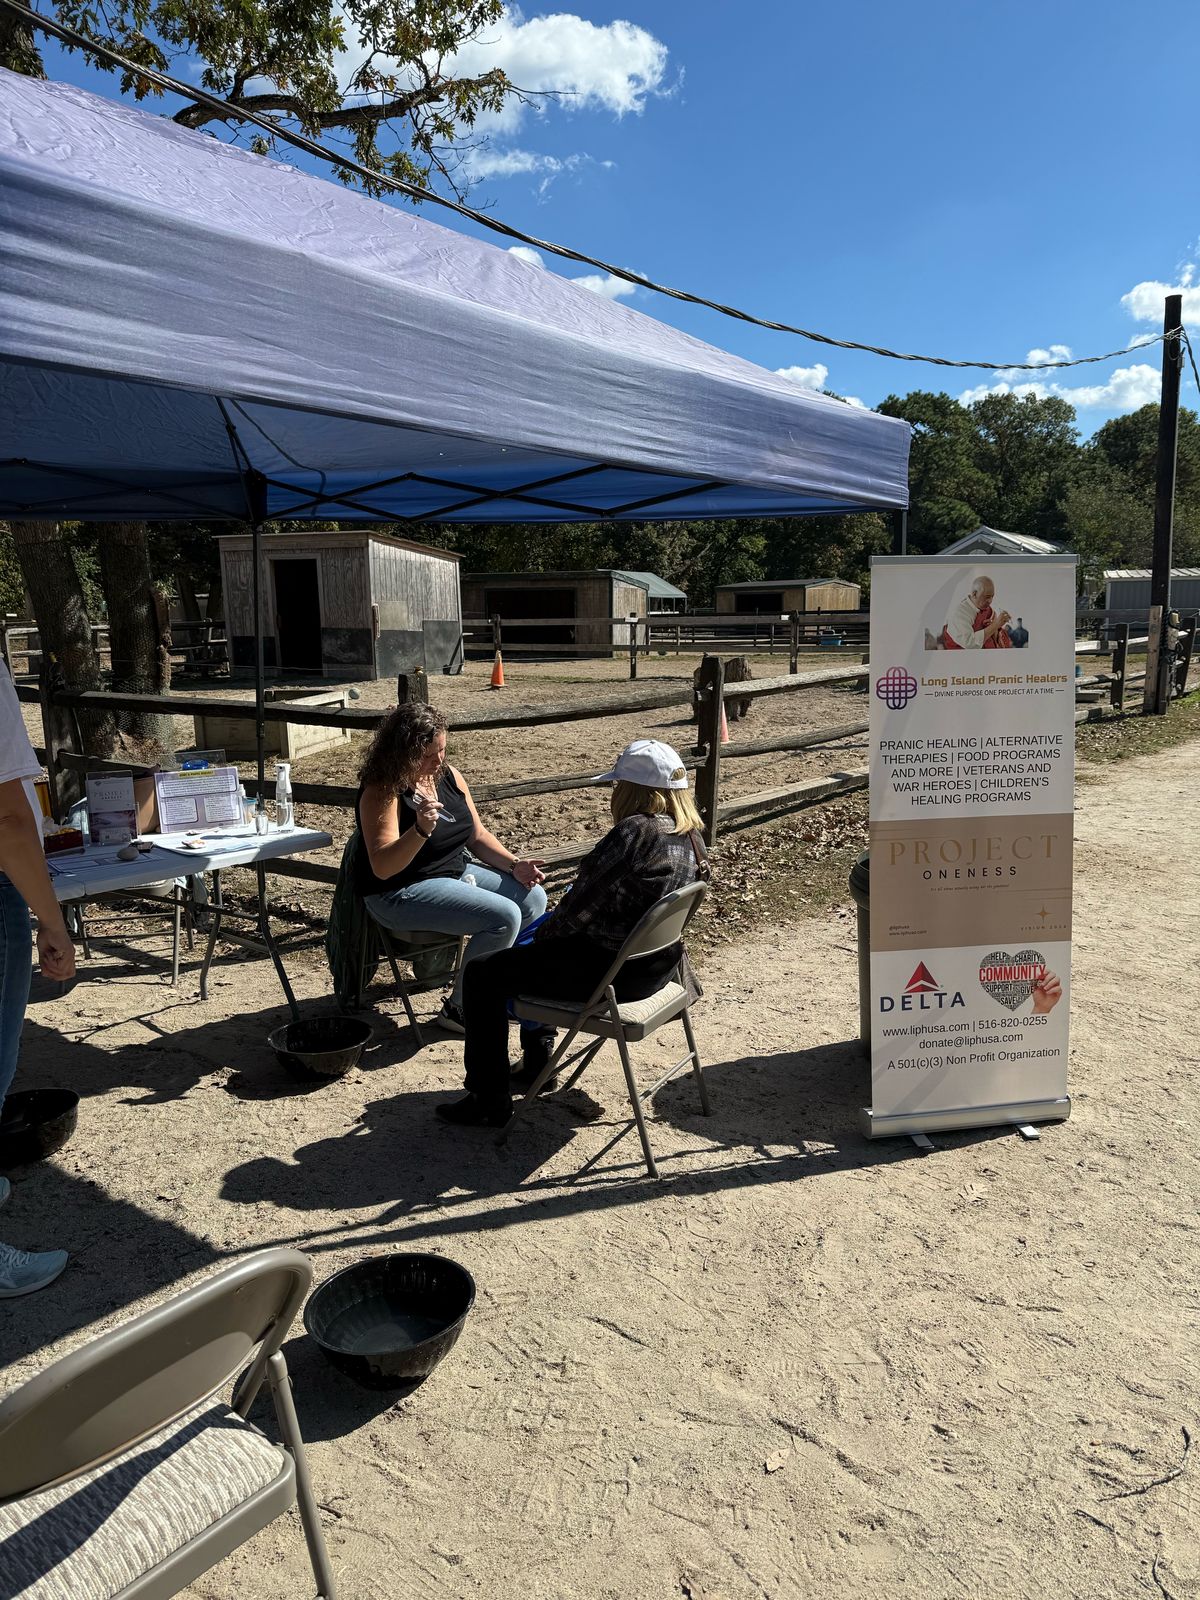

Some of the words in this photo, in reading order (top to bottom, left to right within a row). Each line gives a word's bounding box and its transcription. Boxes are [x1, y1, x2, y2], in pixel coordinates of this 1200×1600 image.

[921, 677, 948, 687] Long
[951, 676, 985, 686] Island
[988, 675, 1023, 684] Pranic
[1026, 674, 1068, 683] Healers
[956, 689, 983, 697] PURPOSE
[879, 739, 924, 750] PRANIC
[927, 737, 977, 748] HEALING
[985, 735, 1063, 747] ALTERNATIVE
[882, 753, 948, 764] THERAPIES
[957, 752, 990, 762] FOOD
[993, 749, 1061, 760] PROGRAMS
[891, 768, 916, 778] AND
[919, 767, 953, 777] MORE
[963, 764, 1025, 775] VETERANS
[1027, 763, 1051, 773] AND
[893, 782, 920, 792] WAR
[923, 780, 972, 791] HEROES
[980, 777, 1049, 788] CHILDREN'S
[911, 794, 962, 805] HEALING
[965, 791, 1031, 803] PROGRAMS
[889, 835, 1058, 865] PROJECT
[922, 866, 1017, 880] ONENESS
[991, 952, 1007, 961] HELP
[1014, 953, 1041, 963] CHARITY
[979, 963, 1046, 982] COMMUNITY
[985, 983, 1013, 993] SUPPORT
[1020, 986, 1034, 994] GIVE
[880, 991, 966, 1012] DELTA
[1000, 996, 1016, 1005] SAVE
[883, 1022, 970, 1036] www.liphusa.com
[978, 1016, 1048, 1030] 516-820-0255
[919, 1032, 1023, 1049] donate@liphusa.com
[887, 1060, 895, 1070] A
[897, 1056, 943, 1070] 501(c)(3)
[946, 1055, 967, 1066] Non
[970, 1052, 995, 1064] Profit
[998, 1047, 1060, 1062] Organization
